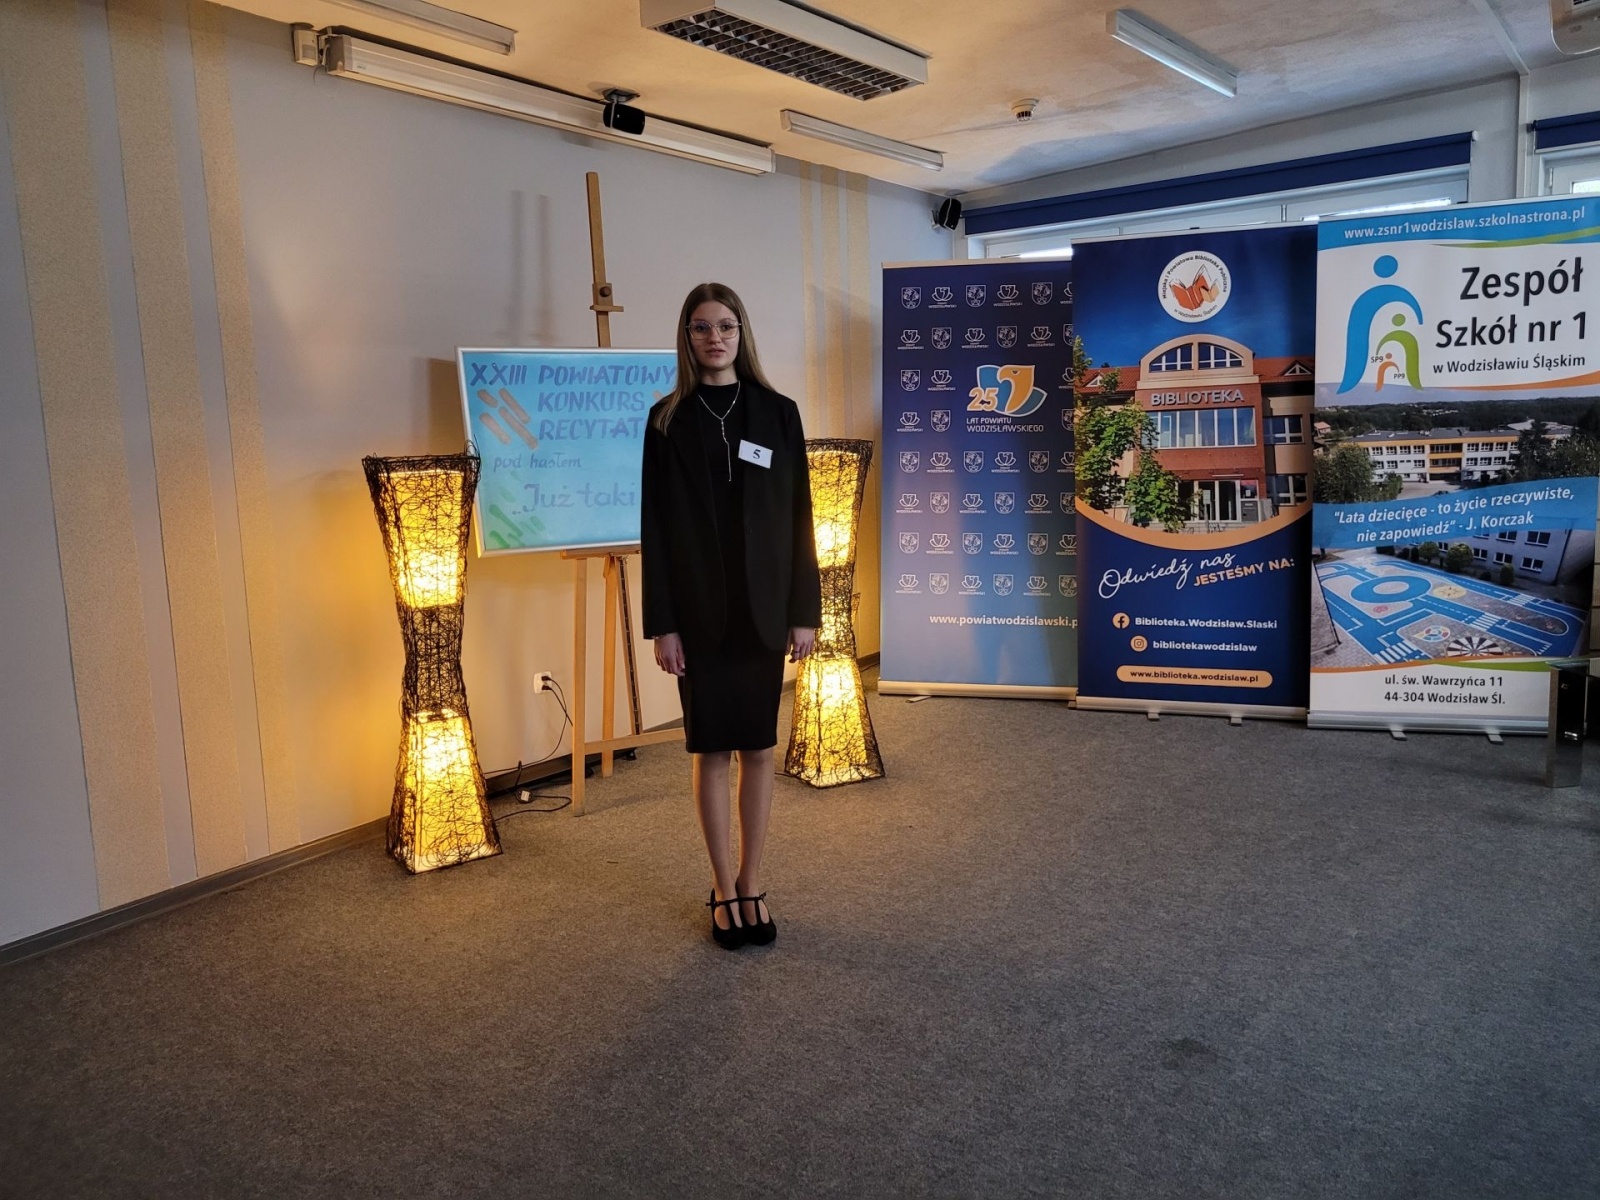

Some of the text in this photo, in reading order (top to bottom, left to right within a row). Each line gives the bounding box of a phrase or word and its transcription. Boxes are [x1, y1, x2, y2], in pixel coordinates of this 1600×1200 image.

[1344, 206, 1585, 240] www.zsnr1wodzislaw.szkolnastrona.pl
[1459, 256, 1584, 307] Zespół
[1435, 311, 1586, 349] Szkół nr 1
[470, 362, 678, 387] XXIII POWIATOWY
[1433, 353, 1586, 374] w Wodzisławiu Śląskim
[537, 391, 646, 413] KONKURS
[966, 386, 999, 412] 25
[1151, 388, 1245, 407] BIBLIOTEKA
[538, 416, 644, 441] RECYTAT
[966, 424, 1044, 433] WODZISŁAWSKIEGO
[493, 452, 522, 473] pod
[752, 448, 761, 460] 5
[576, 482, 637, 507] taki
[1368, 506, 1427, 522] dziecięce
[1438, 503, 1451, 514] to
[1454, 496, 1487, 514] życie
[1490, 486, 1574, 506] rzeczywiste,
[1356, 529, 1377, 542] nie
[1465, 517, 1477, 531] J.
[1481, 510, 1535, 529] Korczak
[1098, 552, 1237, 599] Odwiedź nas
[1193, 557, 1295, 587] JESTEŚMY NA:
[929, 614, 1078, 629] www.powiatwodzislawski.p
[1134, 616, 1278, 630] Biblioteka.Wodzislaw.Slaski
[1152, 640, 1258, 652] bibliotekawodzislaw
[1130, 669, 1259, 684] www.biblioteka.wodzislaw.pl
[1384, 674, 1503, 689] ul. św. Wawrzyńca 11
[1384, 691, 1506, 705] 44-304 Wodzisław Śl.
